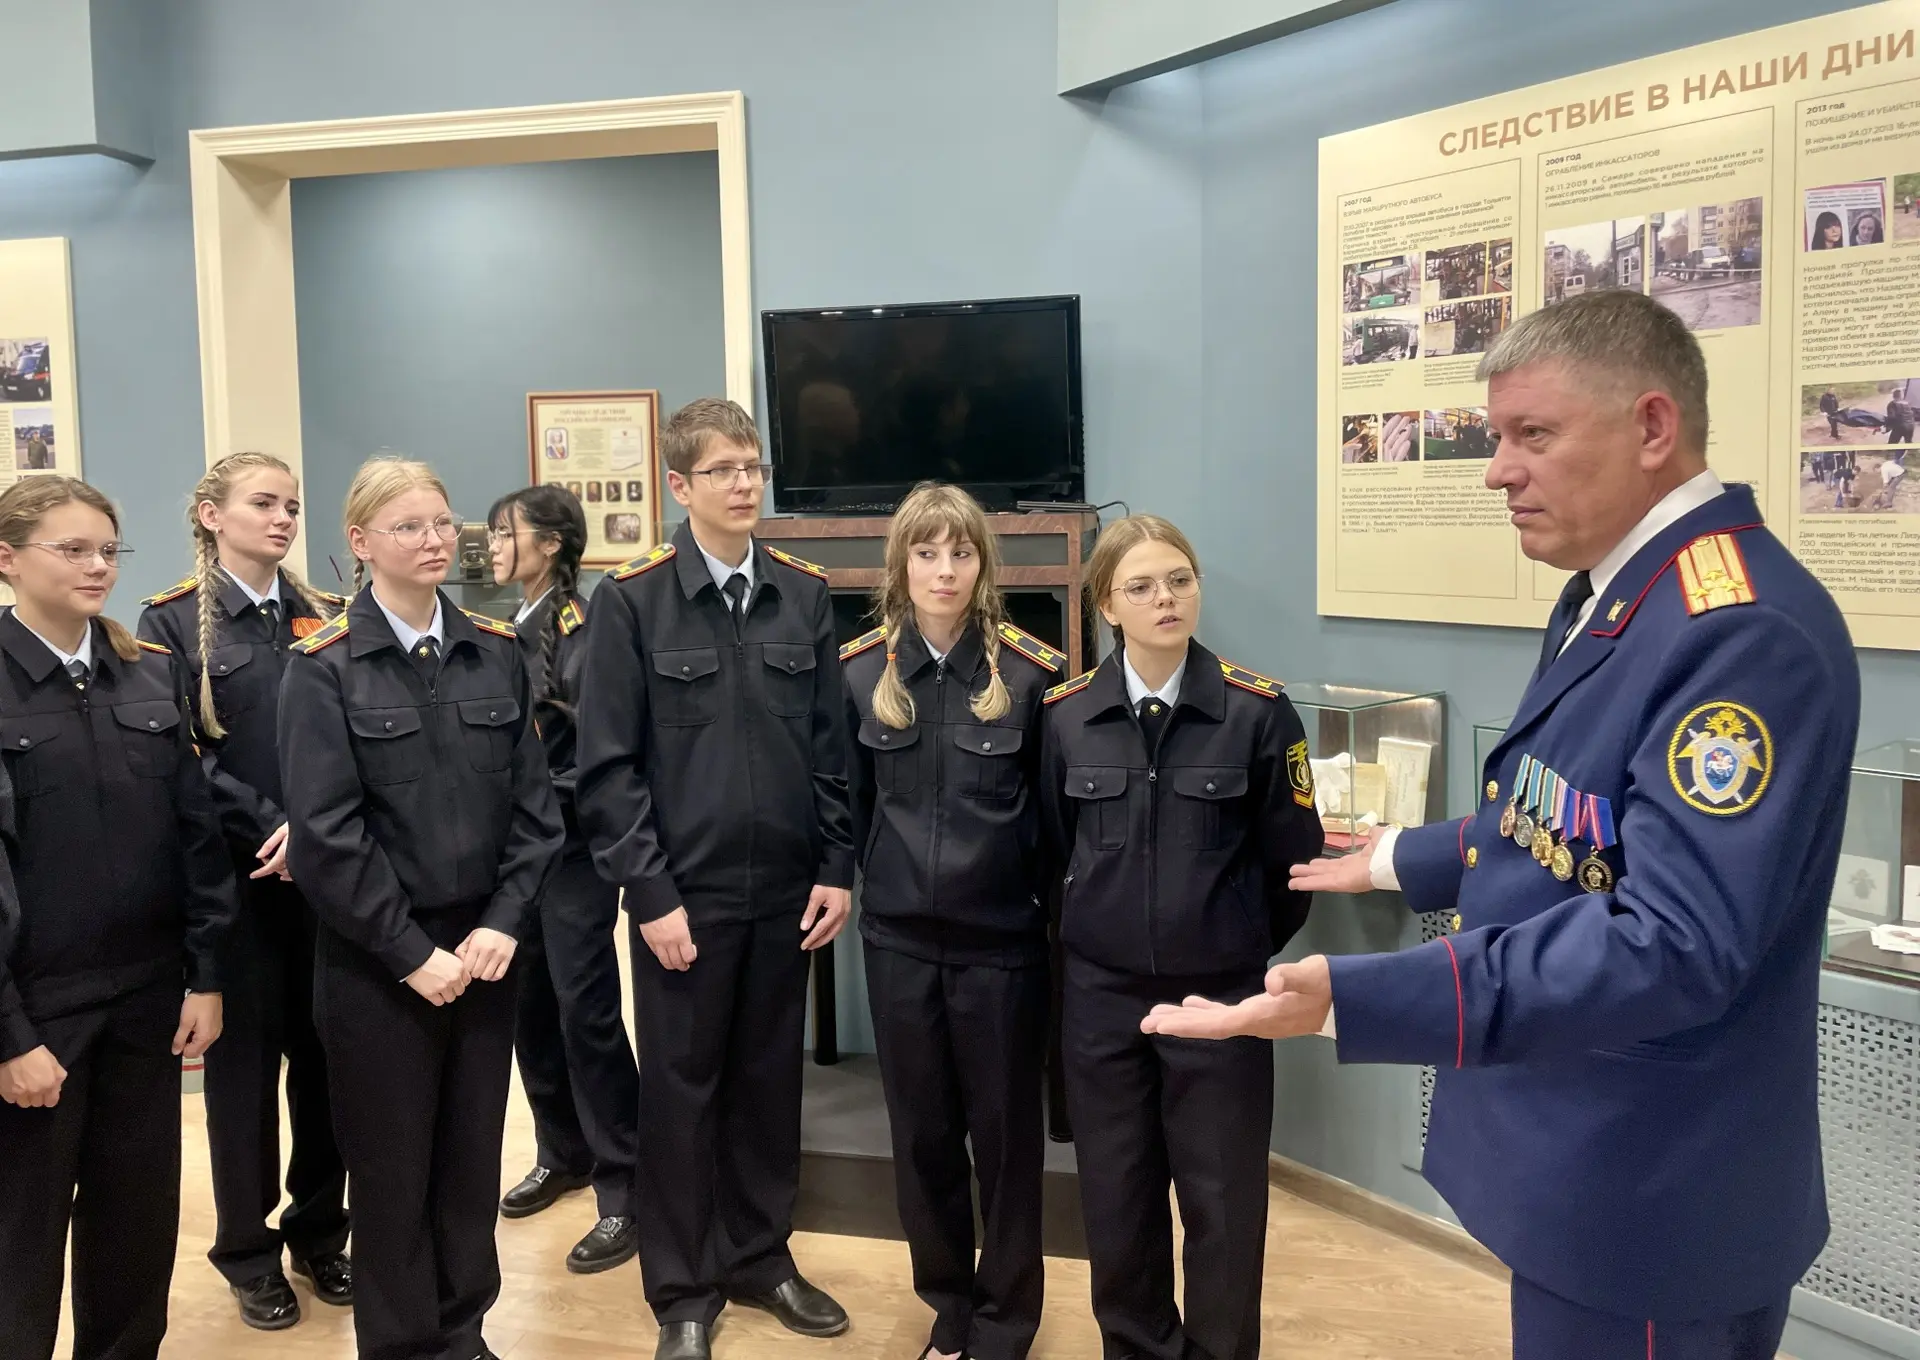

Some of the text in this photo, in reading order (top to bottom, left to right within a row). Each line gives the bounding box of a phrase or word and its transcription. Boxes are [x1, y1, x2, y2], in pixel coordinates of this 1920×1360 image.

[1439, 30, 1914, 156] СЛЕДСТВИЕ В НАШИ ДНИ
[1806, 102, 1845, 115] 2013 год
[1805, 110, 1865, 128] ПОХИЩЕНИЕ
[1805, 123, 1894, 146] В ночь на 24.07.2013
[1545, 153, 1581, 166] 2009 ГОД
[1545, 148, 1660, 177] ОГРАБЛЕНИЕ ИНКАССАТОРОВ
[1545, 179, 1587, 193] 26.11.2009
[1601, 170, 1634, 183] Самаре
[1639, 161, 1690, 176] совершено
[1695, 150, 1747, 166] нападение
[1671, 164, 1718, 179] результате
[1722, 155, 1764, 170] которого
[1363, 199, 1408, 214] МАРШРУТНОГО
[1409, 192, 1443, 204] АВТОБУСА
[1459, 217, 1500, 230] обращение
[1803, 264, 1836, 273] Ночная
[1841, 258, 1884, 270] прогулка
[1809, 278, 1872, 291] подъехавшую
[1873, 274, 1909, 284] машину
[1876, 282, 1915, 293] Назаров
[1803, 294, 1895, 309] хотели сначала лишь
[1853, 304, 1888, 313] машину
[1820, 315, 1856, 325] Лунную,
[1802, 324, 1869, 336] девушки могут
[1802, 335, 1838, 344] привели
[1876, 329, 1918, 339] квартиру
[1802, 344, 1838, 353] Назаров
[1853, 340, 1890, 349] очереди
[1866, 348, 1898, 357] убитых
[1820, 540, 1876, 548] полицейских
[1817, 566, 1884, 575] подозреваемый
